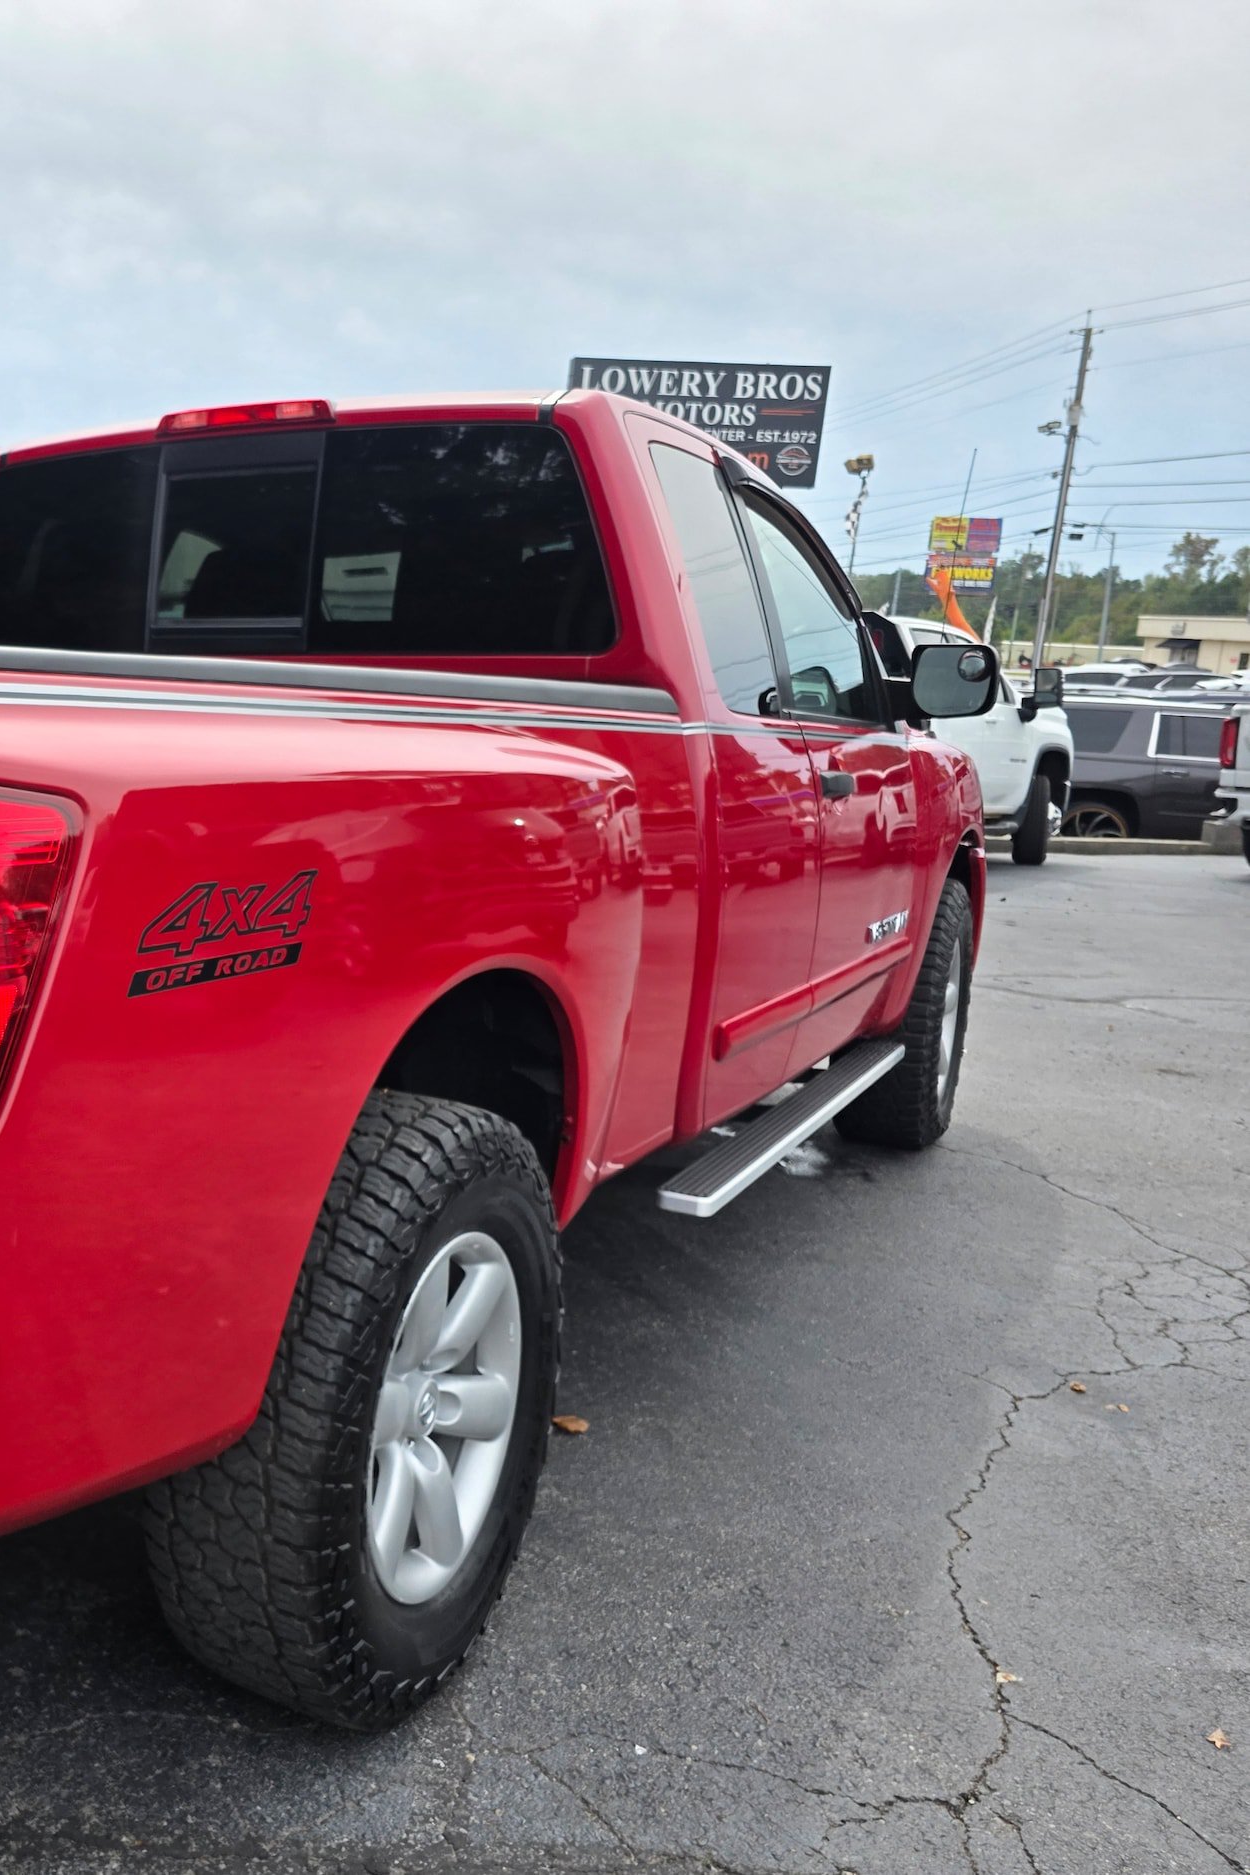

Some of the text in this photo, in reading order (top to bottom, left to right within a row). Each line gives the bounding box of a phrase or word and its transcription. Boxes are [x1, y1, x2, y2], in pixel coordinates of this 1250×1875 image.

[581, 367, 823, 401] LOWERY BROS
[146, 947, 287, 991] OFF ROAD
